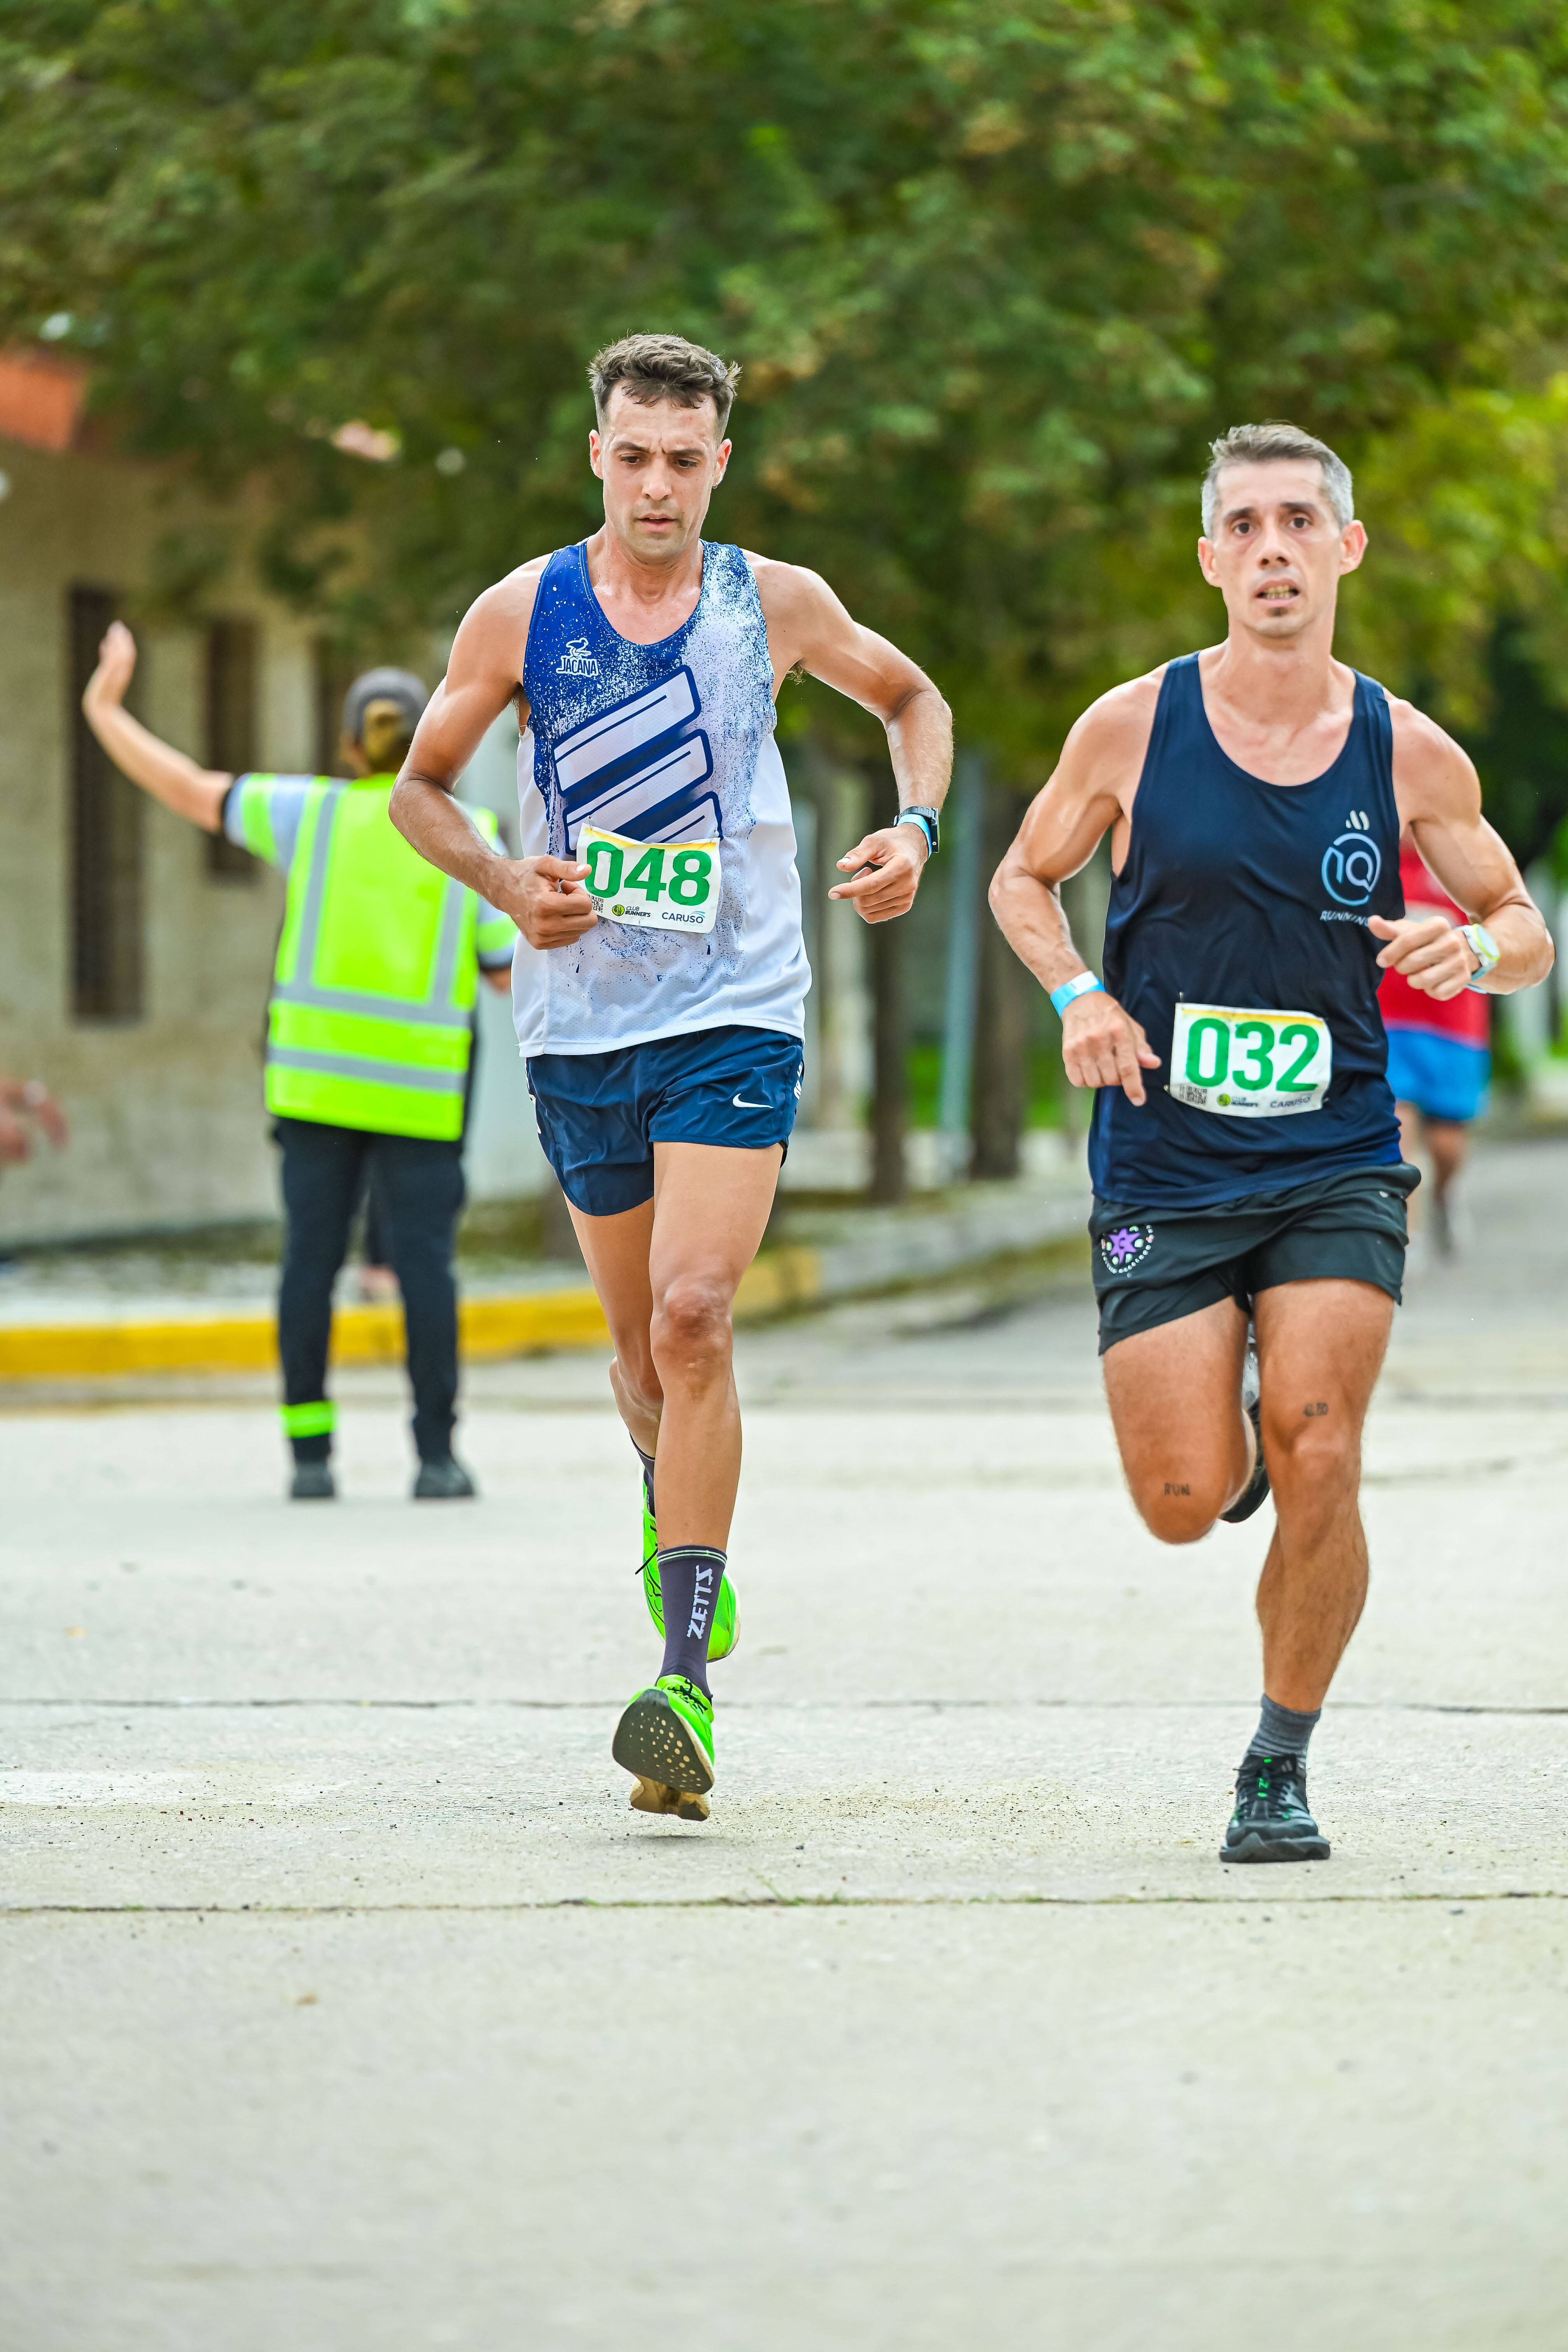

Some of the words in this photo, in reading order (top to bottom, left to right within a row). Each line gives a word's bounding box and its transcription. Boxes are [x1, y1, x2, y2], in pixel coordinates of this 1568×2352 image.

[556, 657, 598, 676] JACANA
[584, 841, 712, 906] 048
[662, 912, 704, 924] CARUSO
[1186, 1018, 1320, 1092] 032
[1270, 1096, 1311, 1108] CARUSO
[1164, 1482, 1191, 1496] RUN
[686, 1564, 713, 1640] ZETTS
